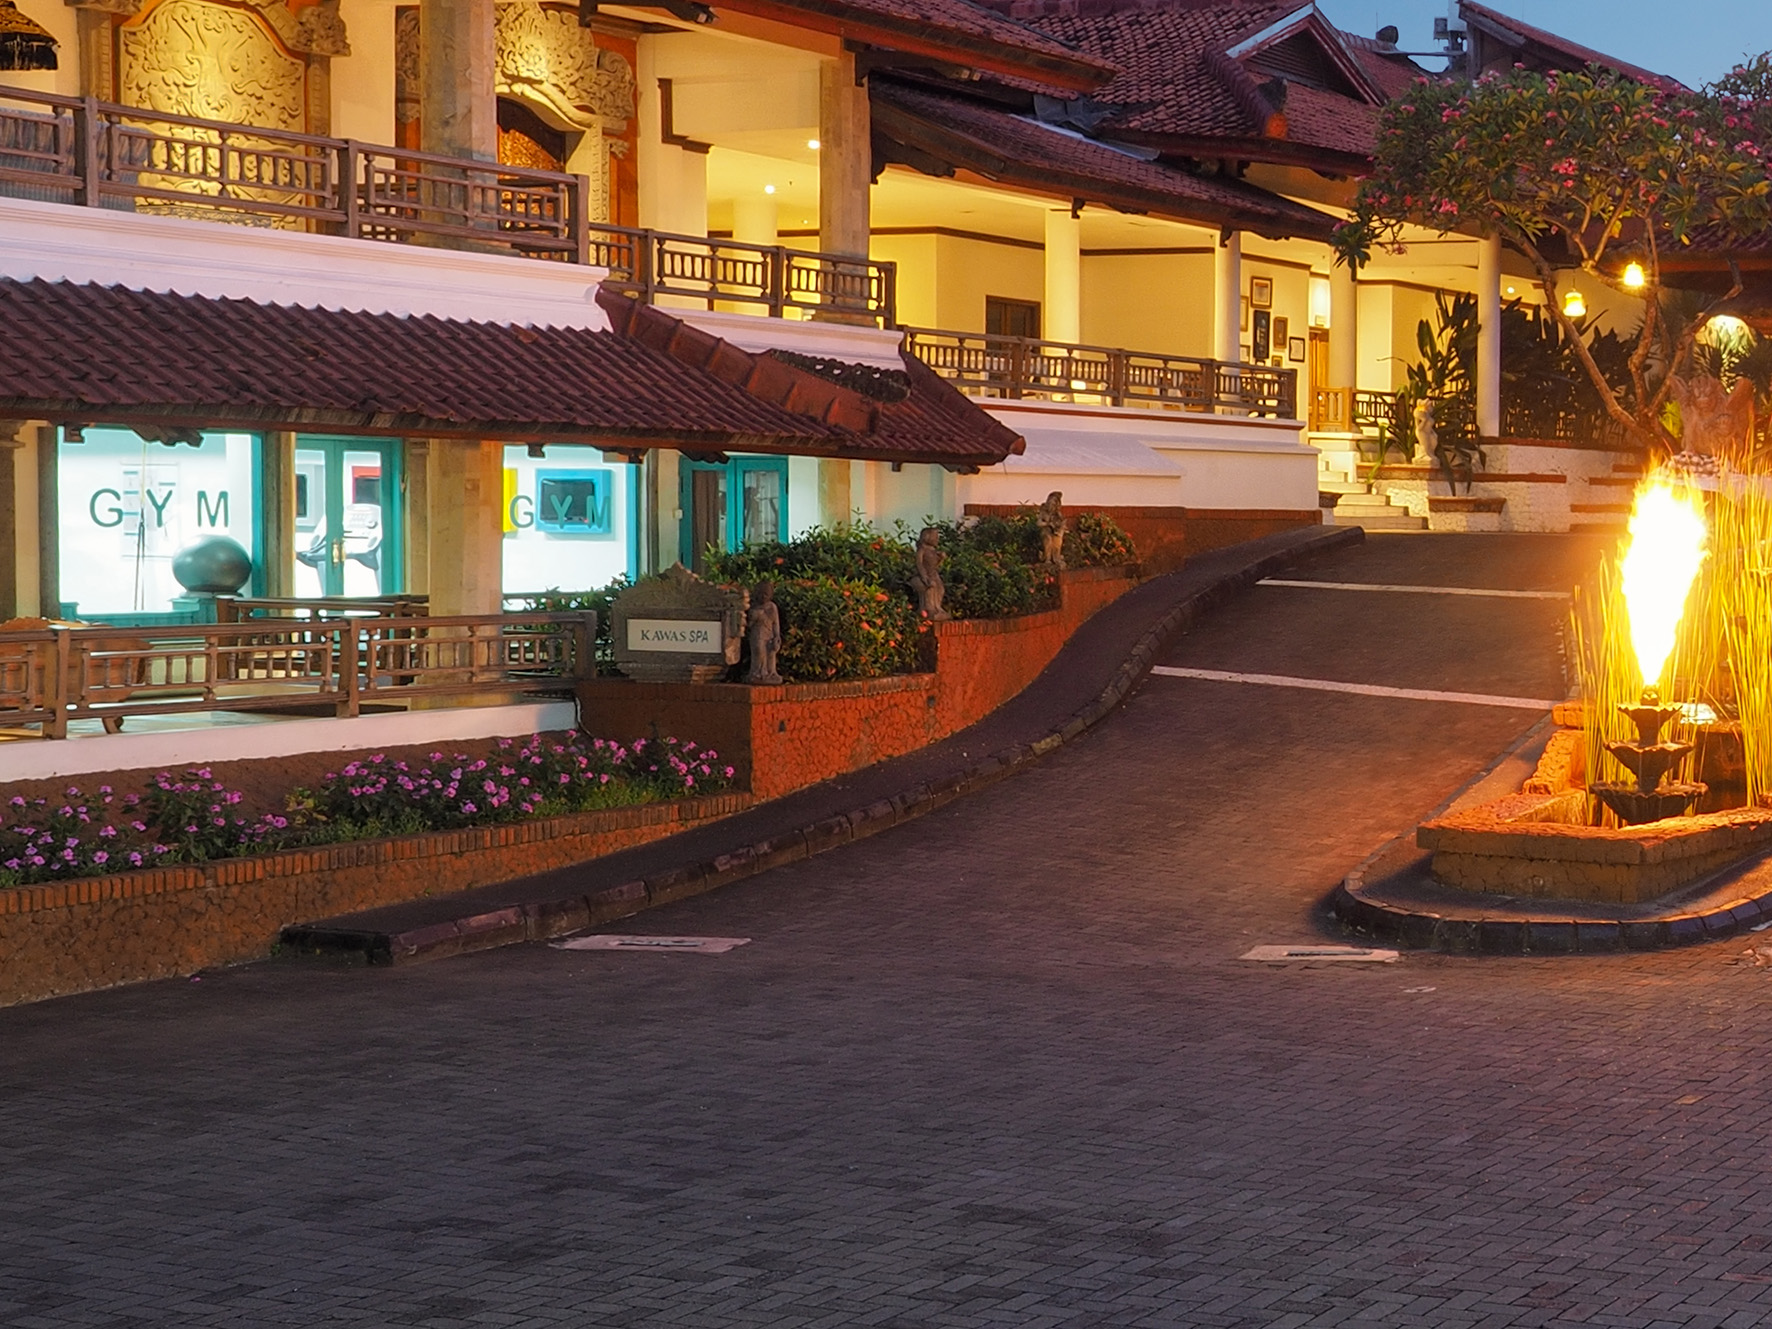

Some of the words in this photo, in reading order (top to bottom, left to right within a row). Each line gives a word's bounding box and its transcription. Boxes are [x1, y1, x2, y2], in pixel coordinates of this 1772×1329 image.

[89, 488, 228, 528] GYM
[509, 495, 610, 529] GYM
[641, 629, 686, 642] KAWAS
[689, 630, 709, 643] SPA
